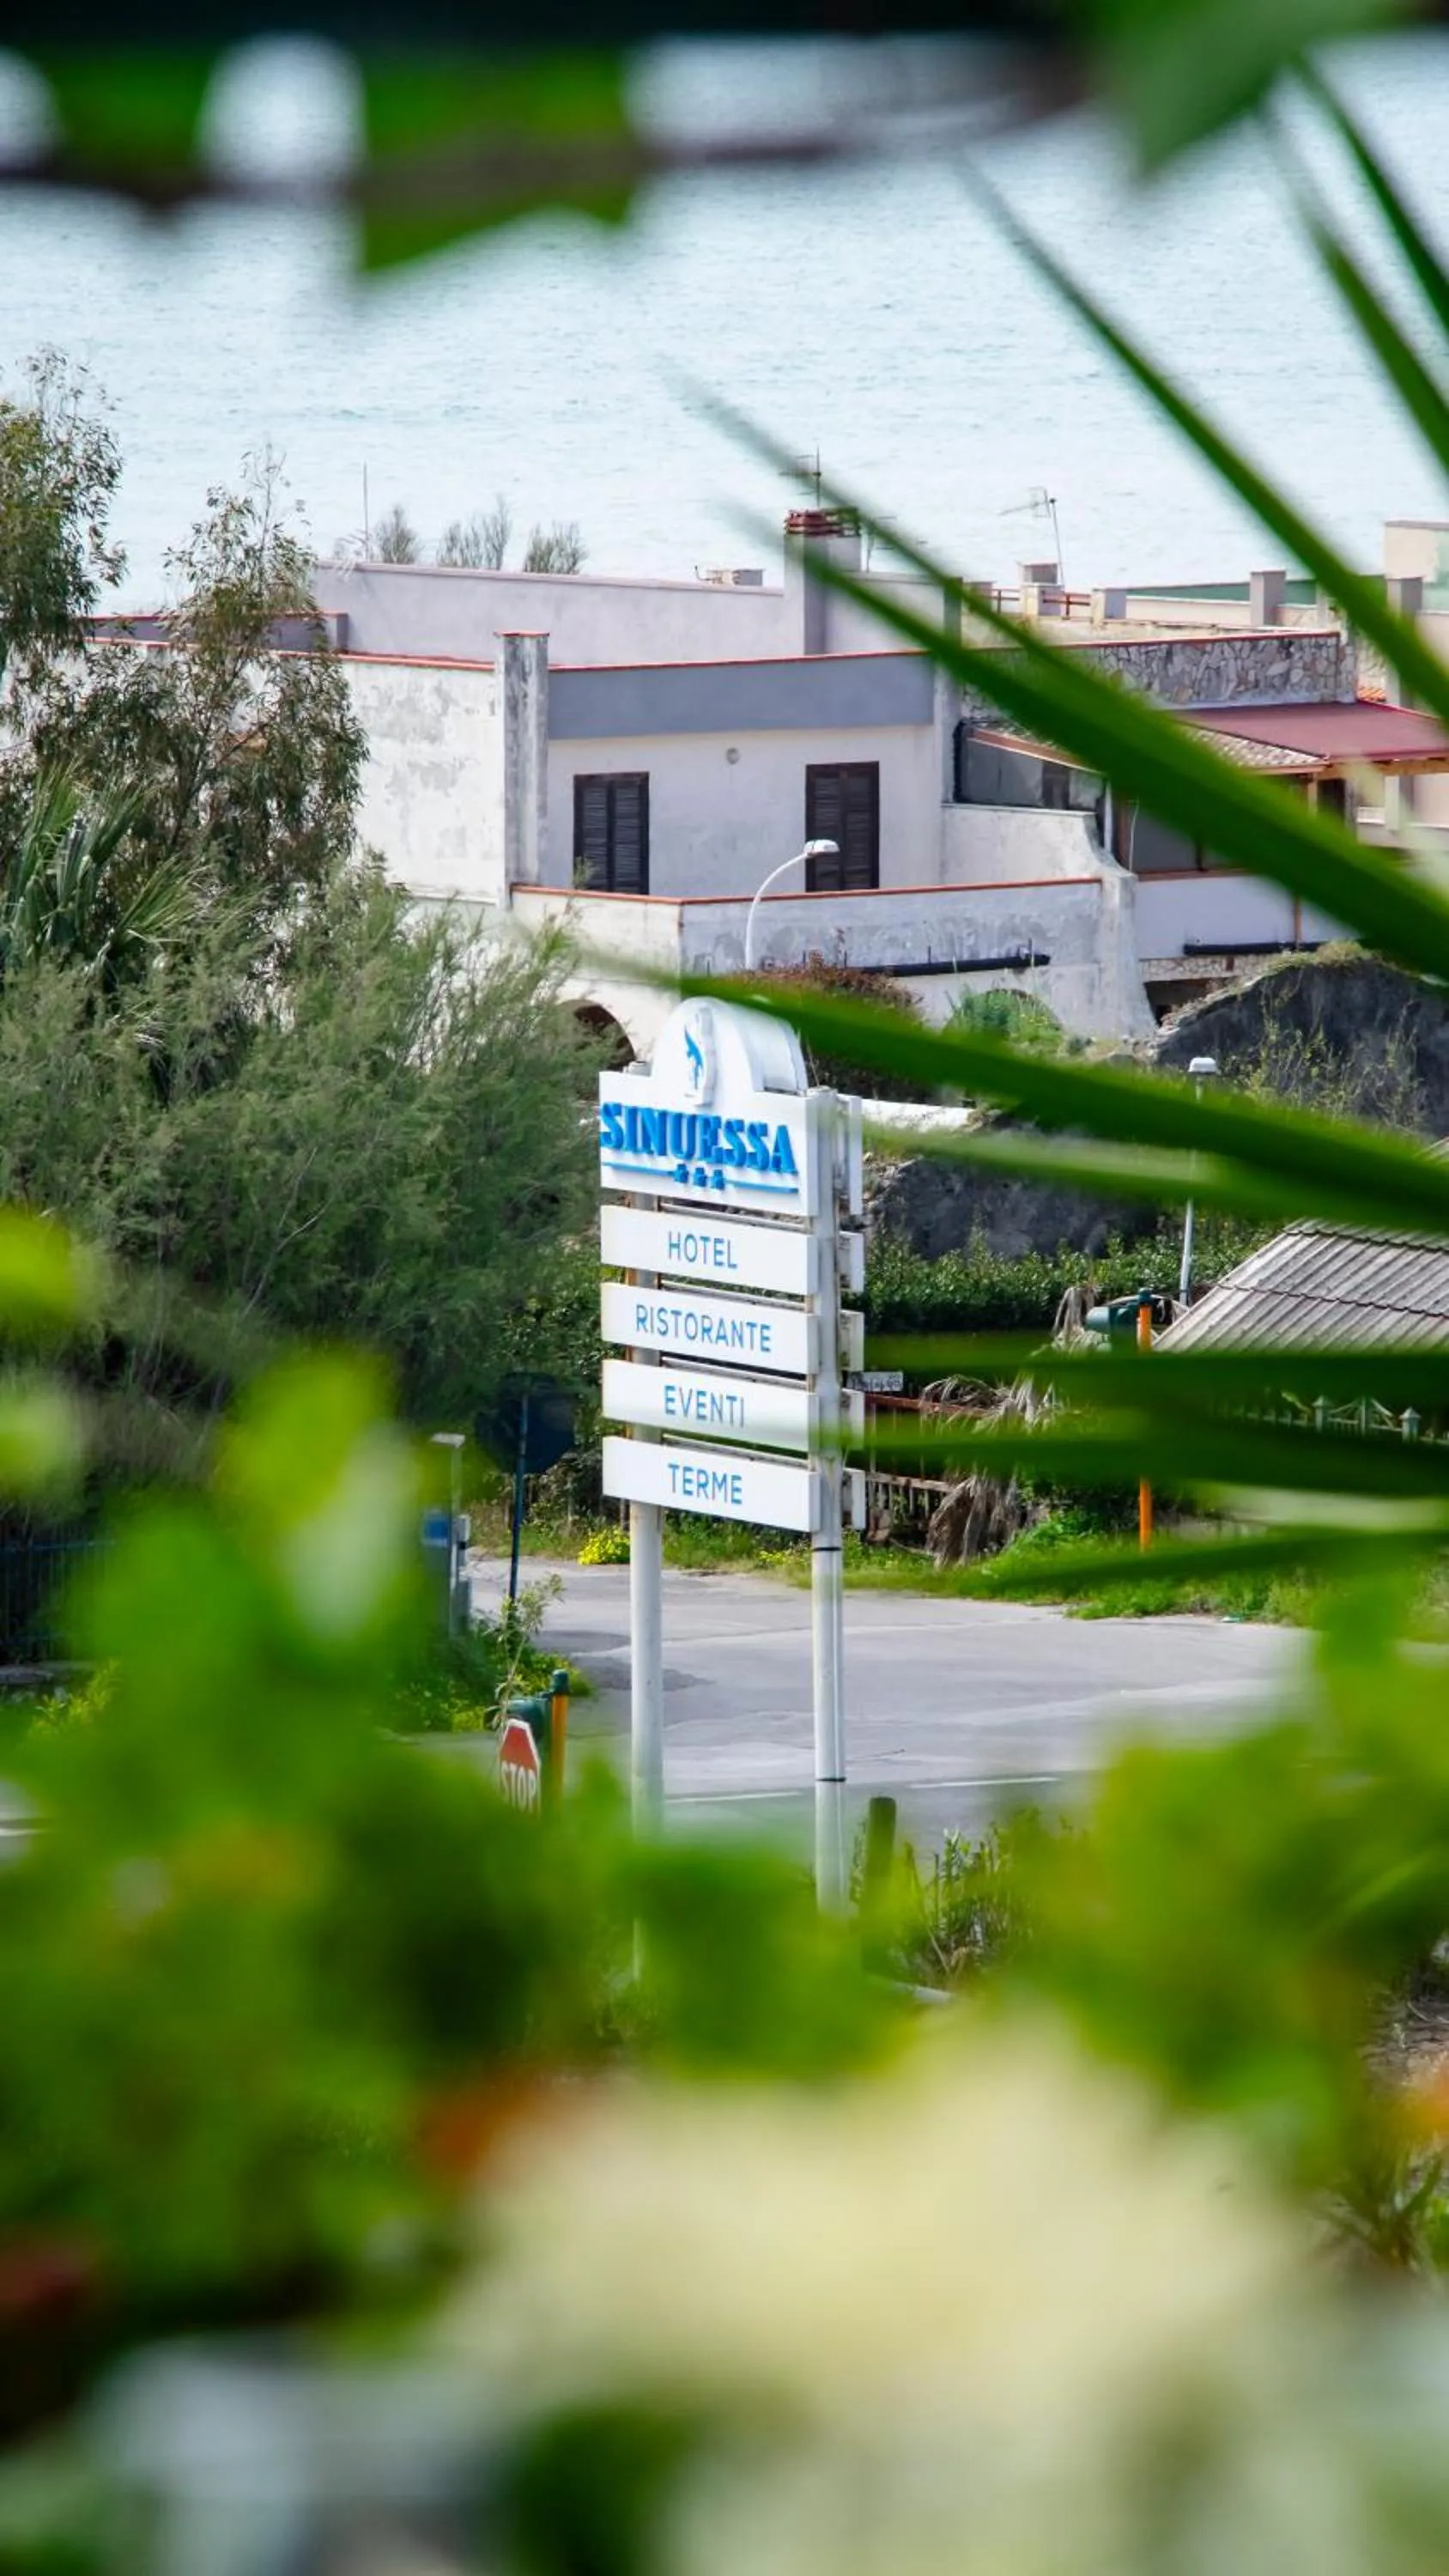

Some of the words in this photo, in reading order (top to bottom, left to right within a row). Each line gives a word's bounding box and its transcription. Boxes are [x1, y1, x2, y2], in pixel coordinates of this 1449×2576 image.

[599, 1103, 798, 1176] SINUESSA
[668, 1230, 738, 1270] HOTEL
[635, 1303, 773, 1352] RISTORANTE
[664, 1384, 745, 1428] EVENTI
[668, 1462, 743, 1505] TERME
[500, 1760, 537, 1814] STOP
